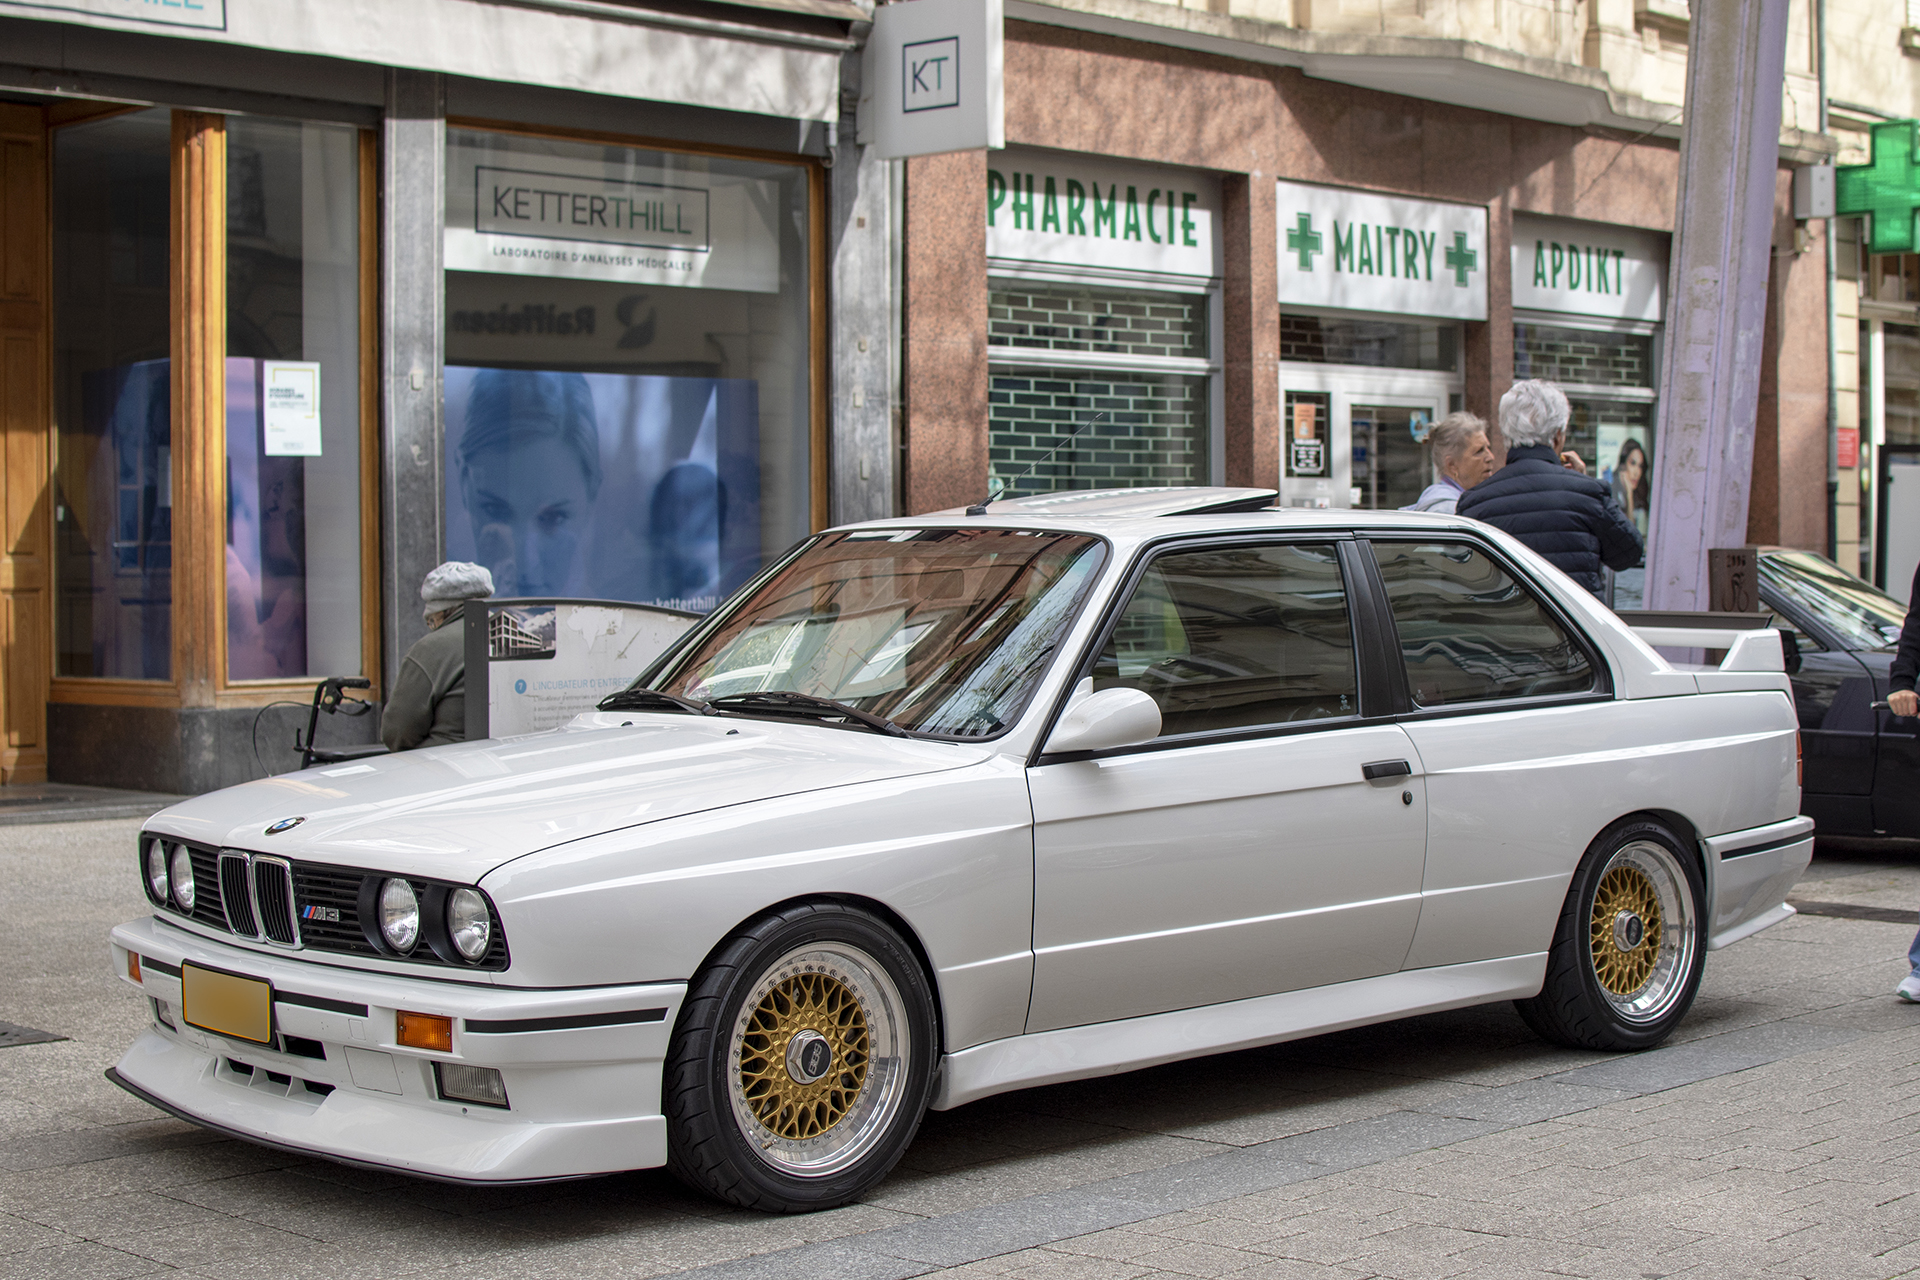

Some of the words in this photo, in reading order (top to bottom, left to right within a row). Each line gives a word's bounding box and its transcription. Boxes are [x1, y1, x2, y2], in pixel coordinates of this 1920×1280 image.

[912, 57, 949, 94] KT
[493, 185, 693, 235] KETTERTHILL
[987, 169, 1198, 248] PHARMACIE
[493, 246, 568, 263] LABORATOIRE
[571, 252, 634, 268] D'ANALYSES
[637, 256, 693, 273] MÉDICALES
[1333, 220, 1436, 281] MAITRY
[1533, 240, 1625, 296] APDIKT
[532, 679, 588, 691] L'INCUBATEUR
[313, 906, 340, 922] M3
[808, 1043, 823, 1075] BBS
